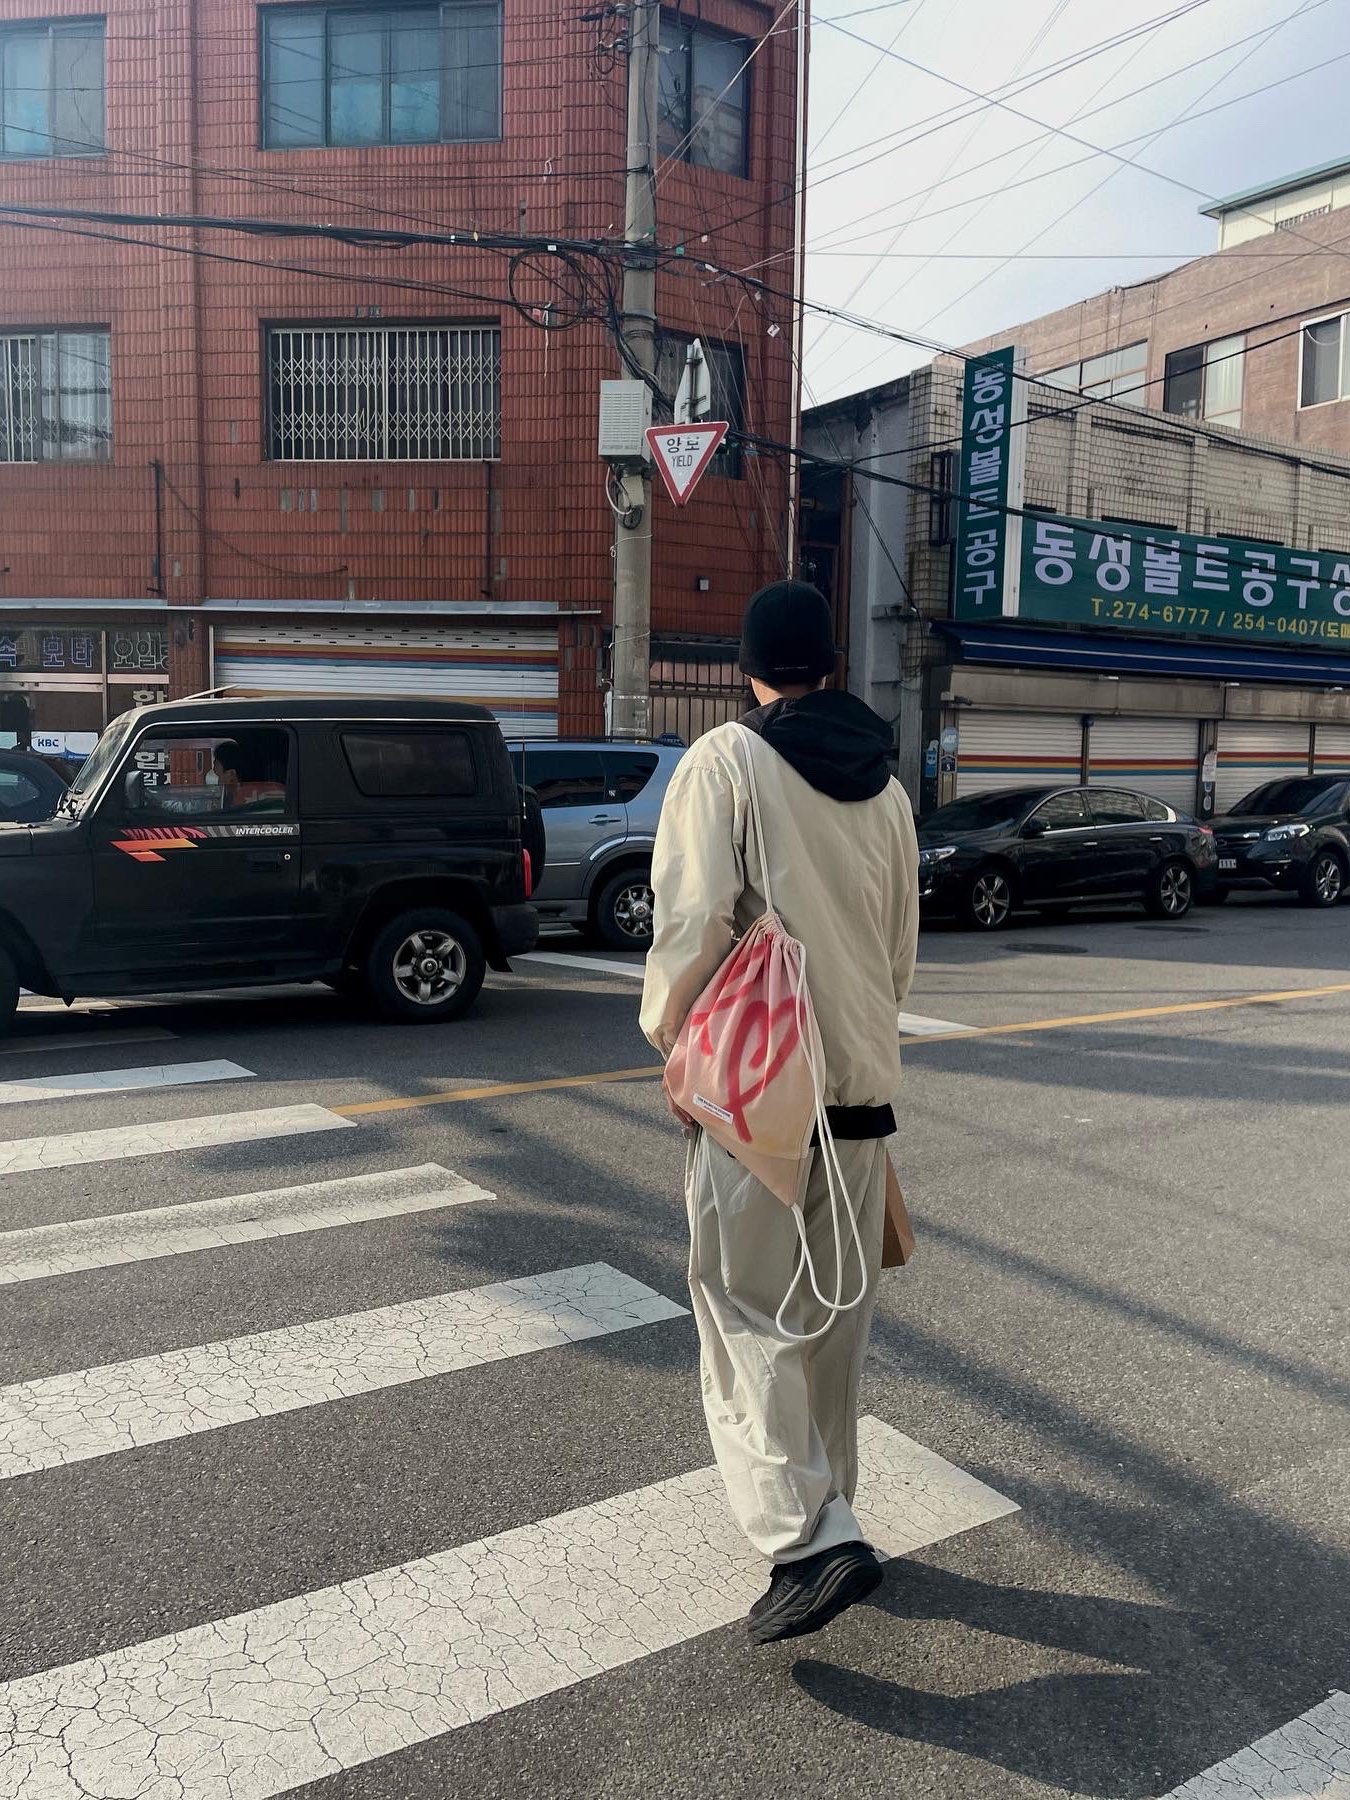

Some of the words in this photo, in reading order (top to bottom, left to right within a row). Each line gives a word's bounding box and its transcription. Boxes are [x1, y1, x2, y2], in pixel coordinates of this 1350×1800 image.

[671, 454, 693, 467] YIELD
[963, 362, 1007, 605] 동성볼트공구
[1091, 598, 1209, 625] T.274-6777
[38, 738, 59, 748] KBC
[235, 826, 294, 836] INTERCOOLER
